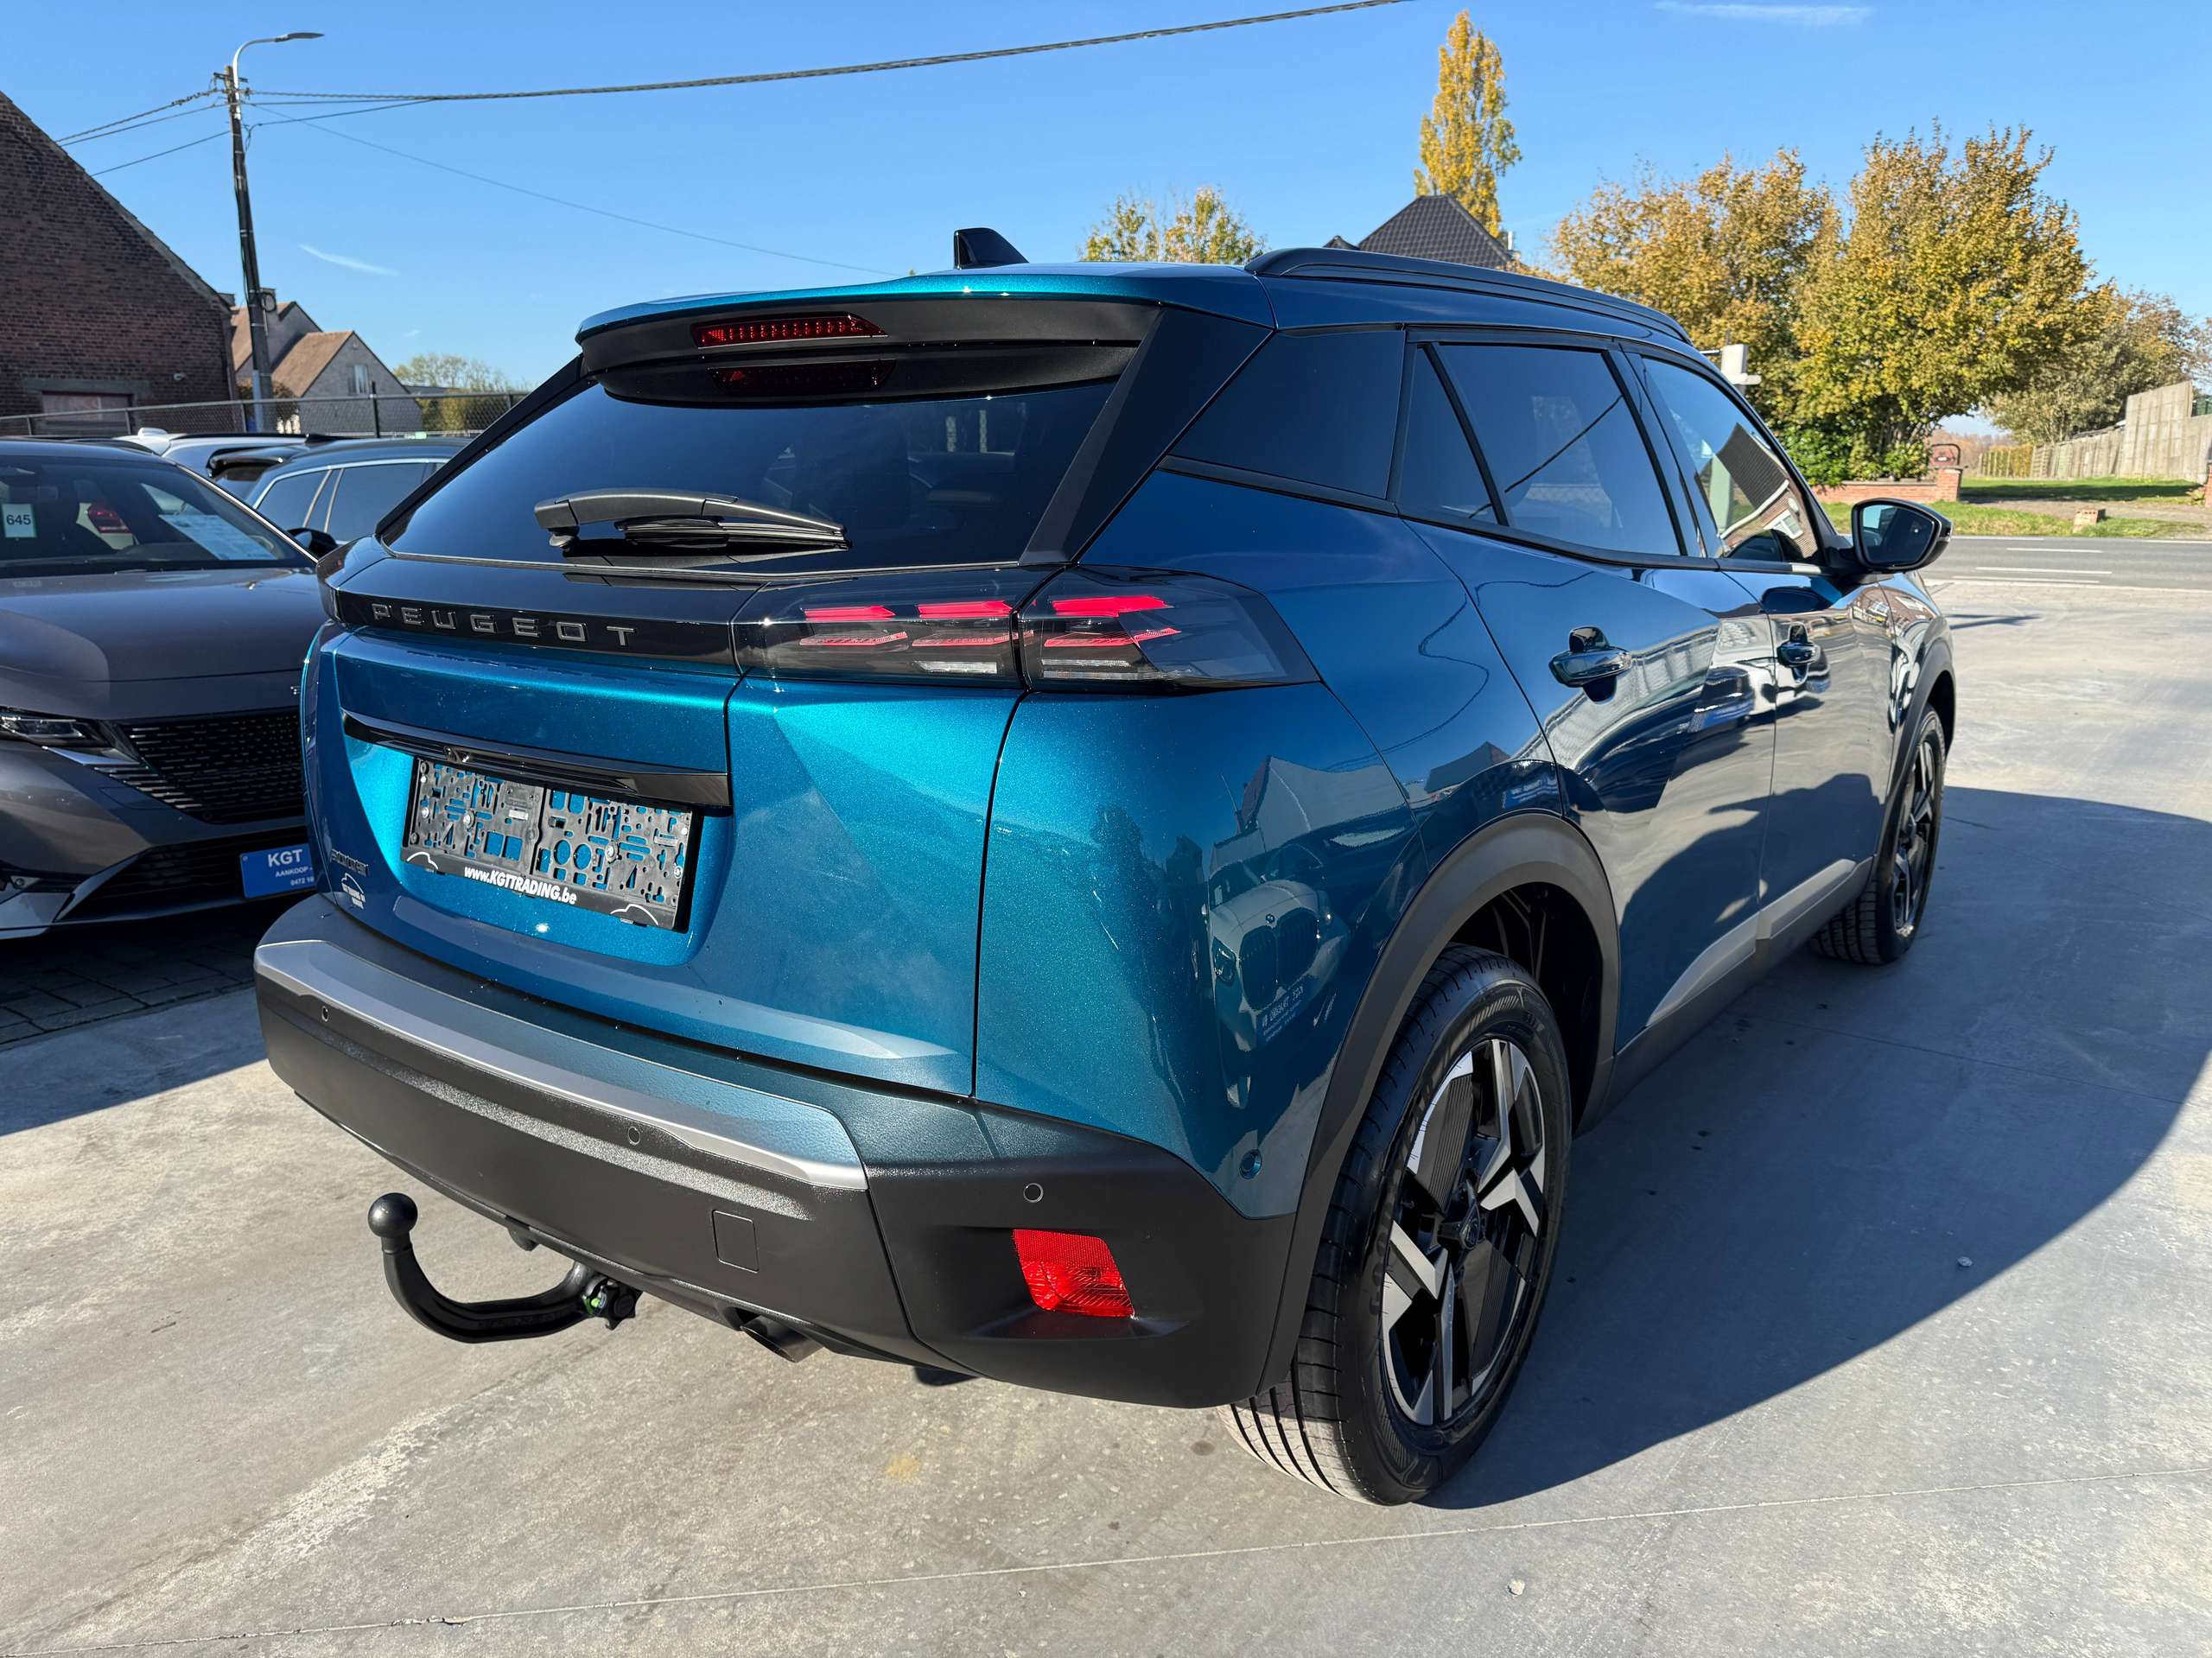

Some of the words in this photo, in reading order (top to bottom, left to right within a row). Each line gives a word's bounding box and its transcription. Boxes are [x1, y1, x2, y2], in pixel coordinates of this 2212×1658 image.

[6, 514, 31, 525] 645
[371, 603, 636, 646] PEUGEOT
[268, 848, 302, 867] KGT
[275, 866, 308, 878] AANKOOP
[464, 867, 577, 905] www.KGTTRADING.be
